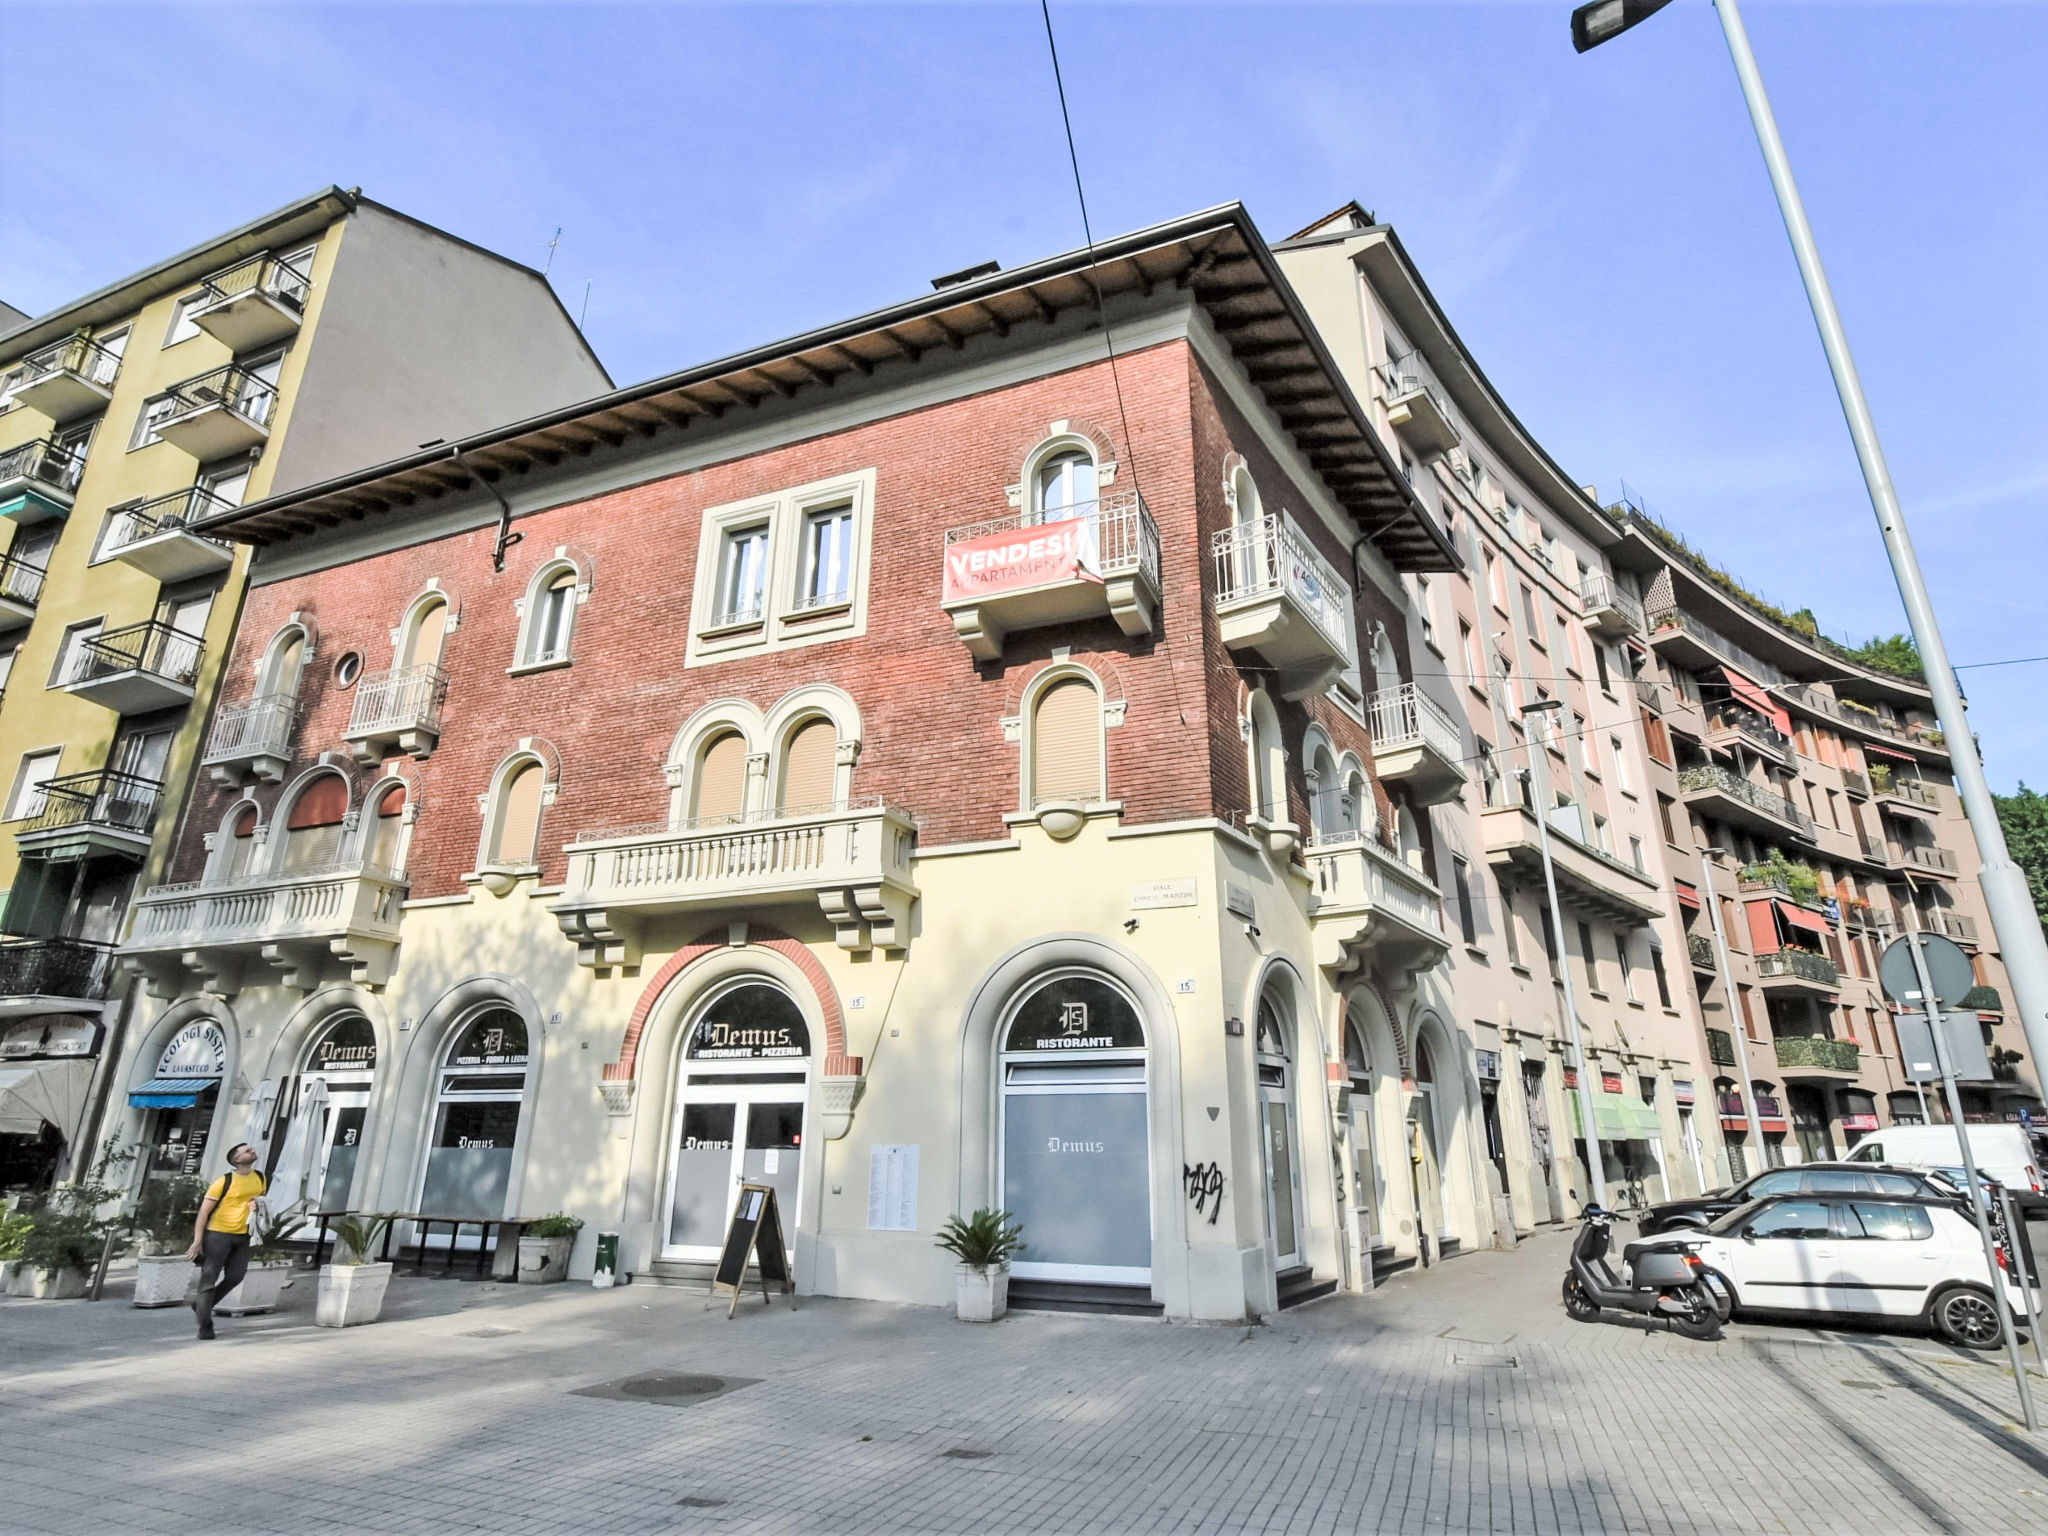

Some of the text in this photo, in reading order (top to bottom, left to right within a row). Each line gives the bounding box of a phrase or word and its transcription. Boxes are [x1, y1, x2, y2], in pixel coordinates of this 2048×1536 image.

[950, 532, 1072, 576] VENDESI
[1162, 891, 1193, 900] MARTINI
[1180, 982, 1190, 991] 15
[711, 1023, 790, 1047] Demus
[1036, 1037, 1113, 1049] RISTORANTE
[158, 1026, 224, 1073] ECOLOGY SYSTEM
[320, 1041, 376, 1061] Demus
[698, 1048, 753, 1059] RISTORANTE
[761, 1047, 803, 1057] PIZZERIA
[323, 1061, 368, 1070] RISTORANTE
[456, 1056, 481, 1064] PIZZERIA
[172, 1064, 209, 1073] LAVASECCO
[2020, 1109, 2027, 1121] P
[458, 1136, 494, 1149] Demus
[686, 1136, 729, 1150] Demus
[1047, 1137, 1104, 1153] Demus
